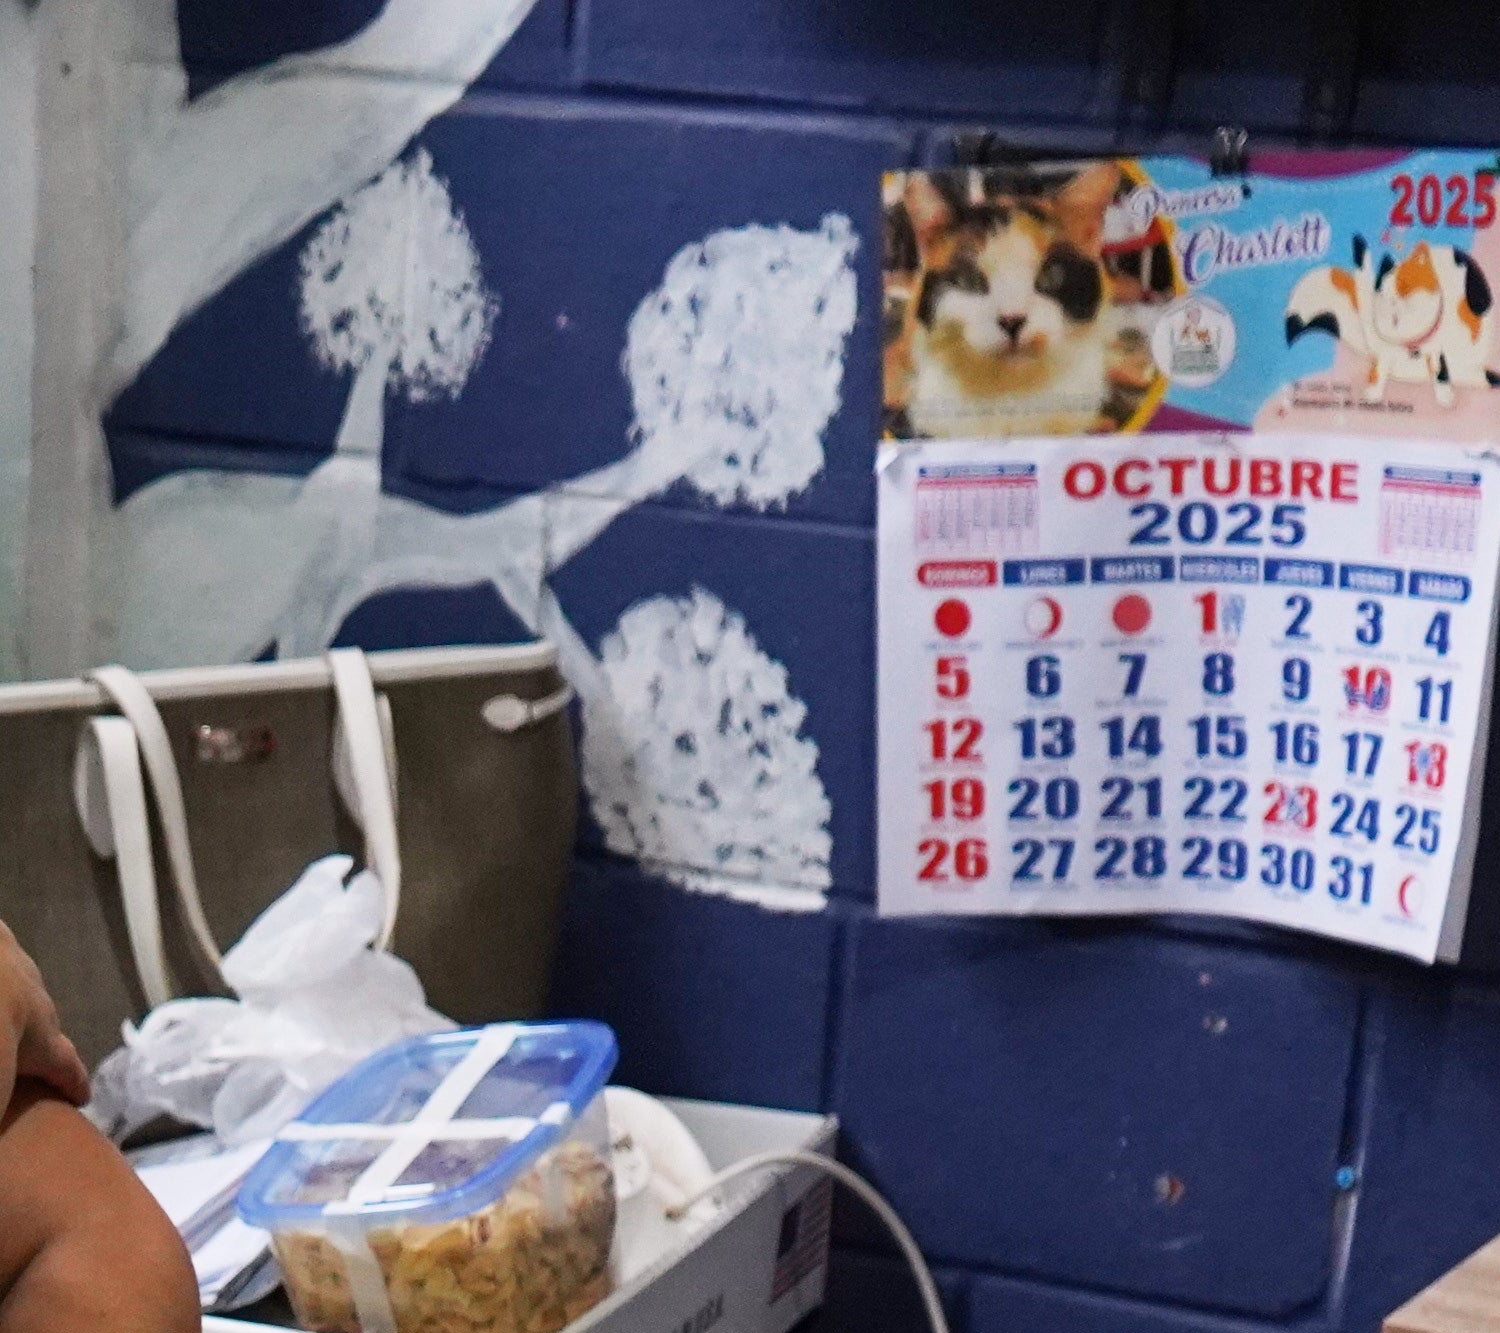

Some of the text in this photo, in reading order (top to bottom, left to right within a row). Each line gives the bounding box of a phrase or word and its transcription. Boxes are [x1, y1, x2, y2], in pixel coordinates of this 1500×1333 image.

[1390, 174, 1496, 228] 2025
[1064, 459, 1357, 500] OCTUBRE
[1129, 503, 1305, 545] 2025
[1103, 563, 1162, 581] MARTES
[1194, 592, 1450, 656] 1 2 3 4
[937, 657, 970, 698] 5
[1028, 656, 1061, 699] 6
[1120, 655, 1145, 695] 7
[1203, 654, 1234, 697] 8
[1282, 659, 1310, 703] 9
[1345, 666, 1391, 708] 10
[1417, 679, 1452, 724] 11
[922, 717, 1447, 788] 12 13 14 15 16 17 18
[924, 777, 1439, 855] 19 20 21 22 23 24 25
[919, 838, 1373, 906] 26 27 28 29 30 31
